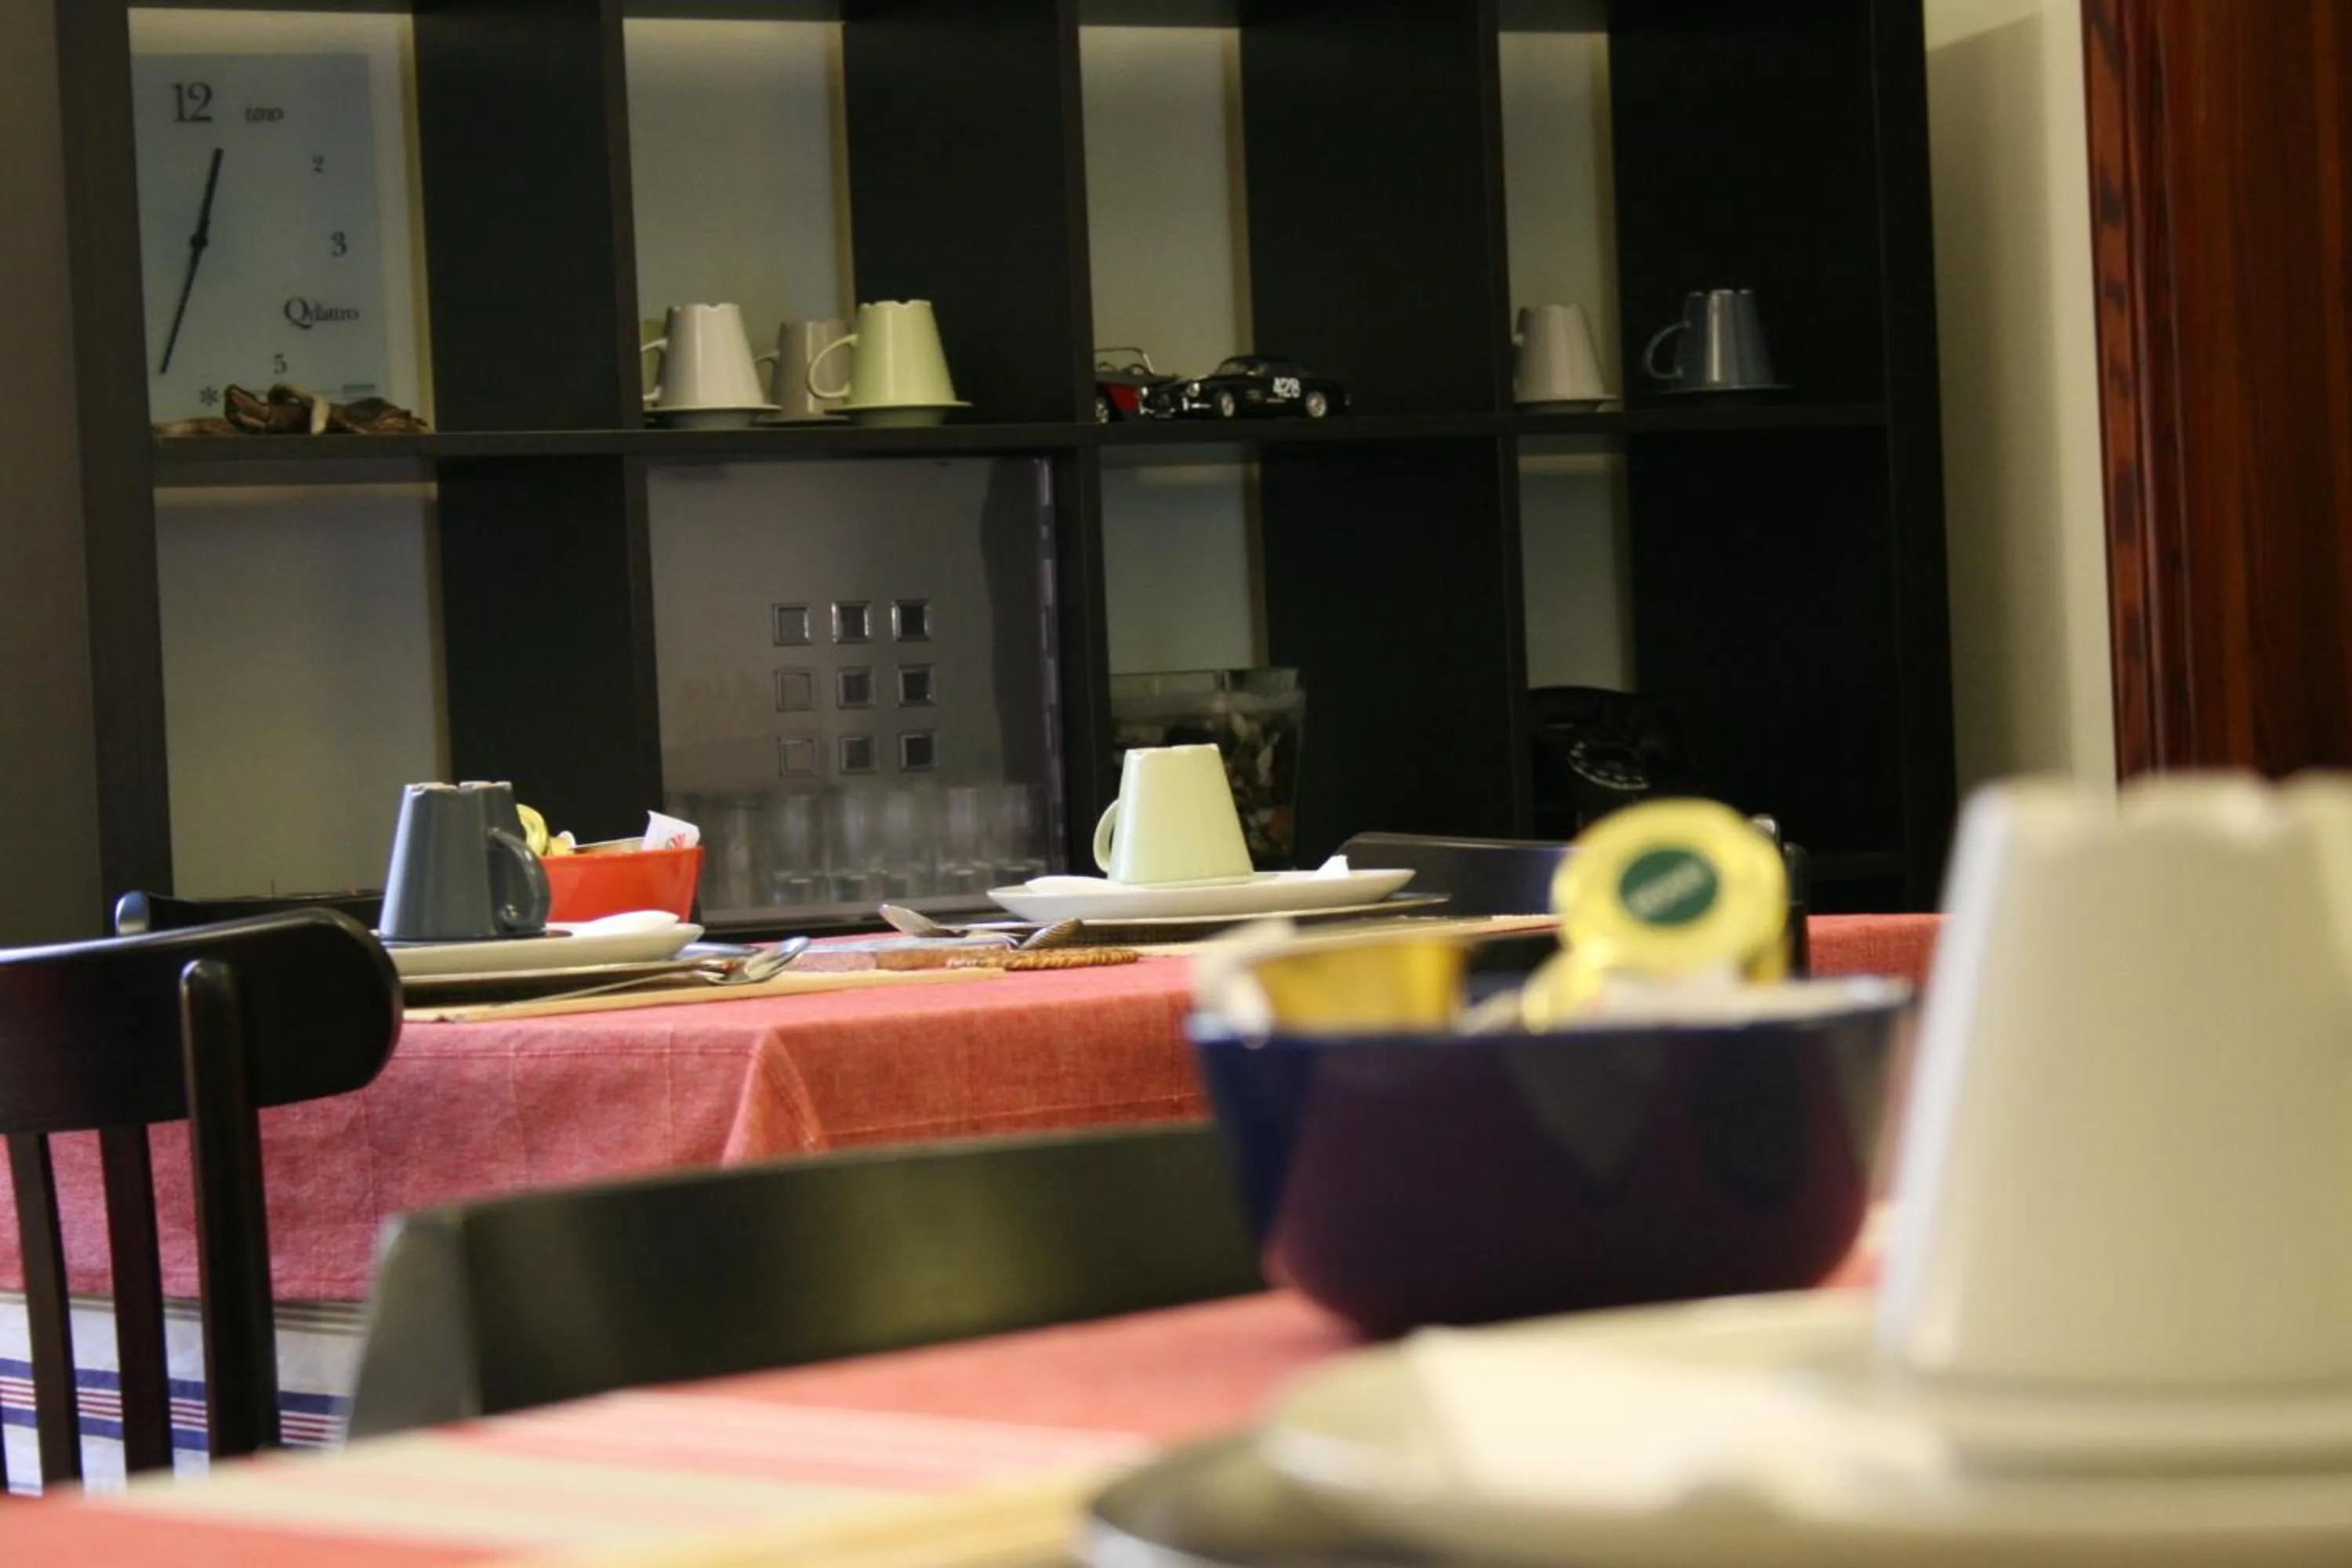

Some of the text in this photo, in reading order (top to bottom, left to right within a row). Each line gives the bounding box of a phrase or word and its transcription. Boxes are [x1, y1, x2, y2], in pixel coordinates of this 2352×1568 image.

[172, 82, 212, 123] 12
[313, 155, 325, 173] 2
[330, 230, 347, 257] 3
[273, 354, 287, 376] 5
